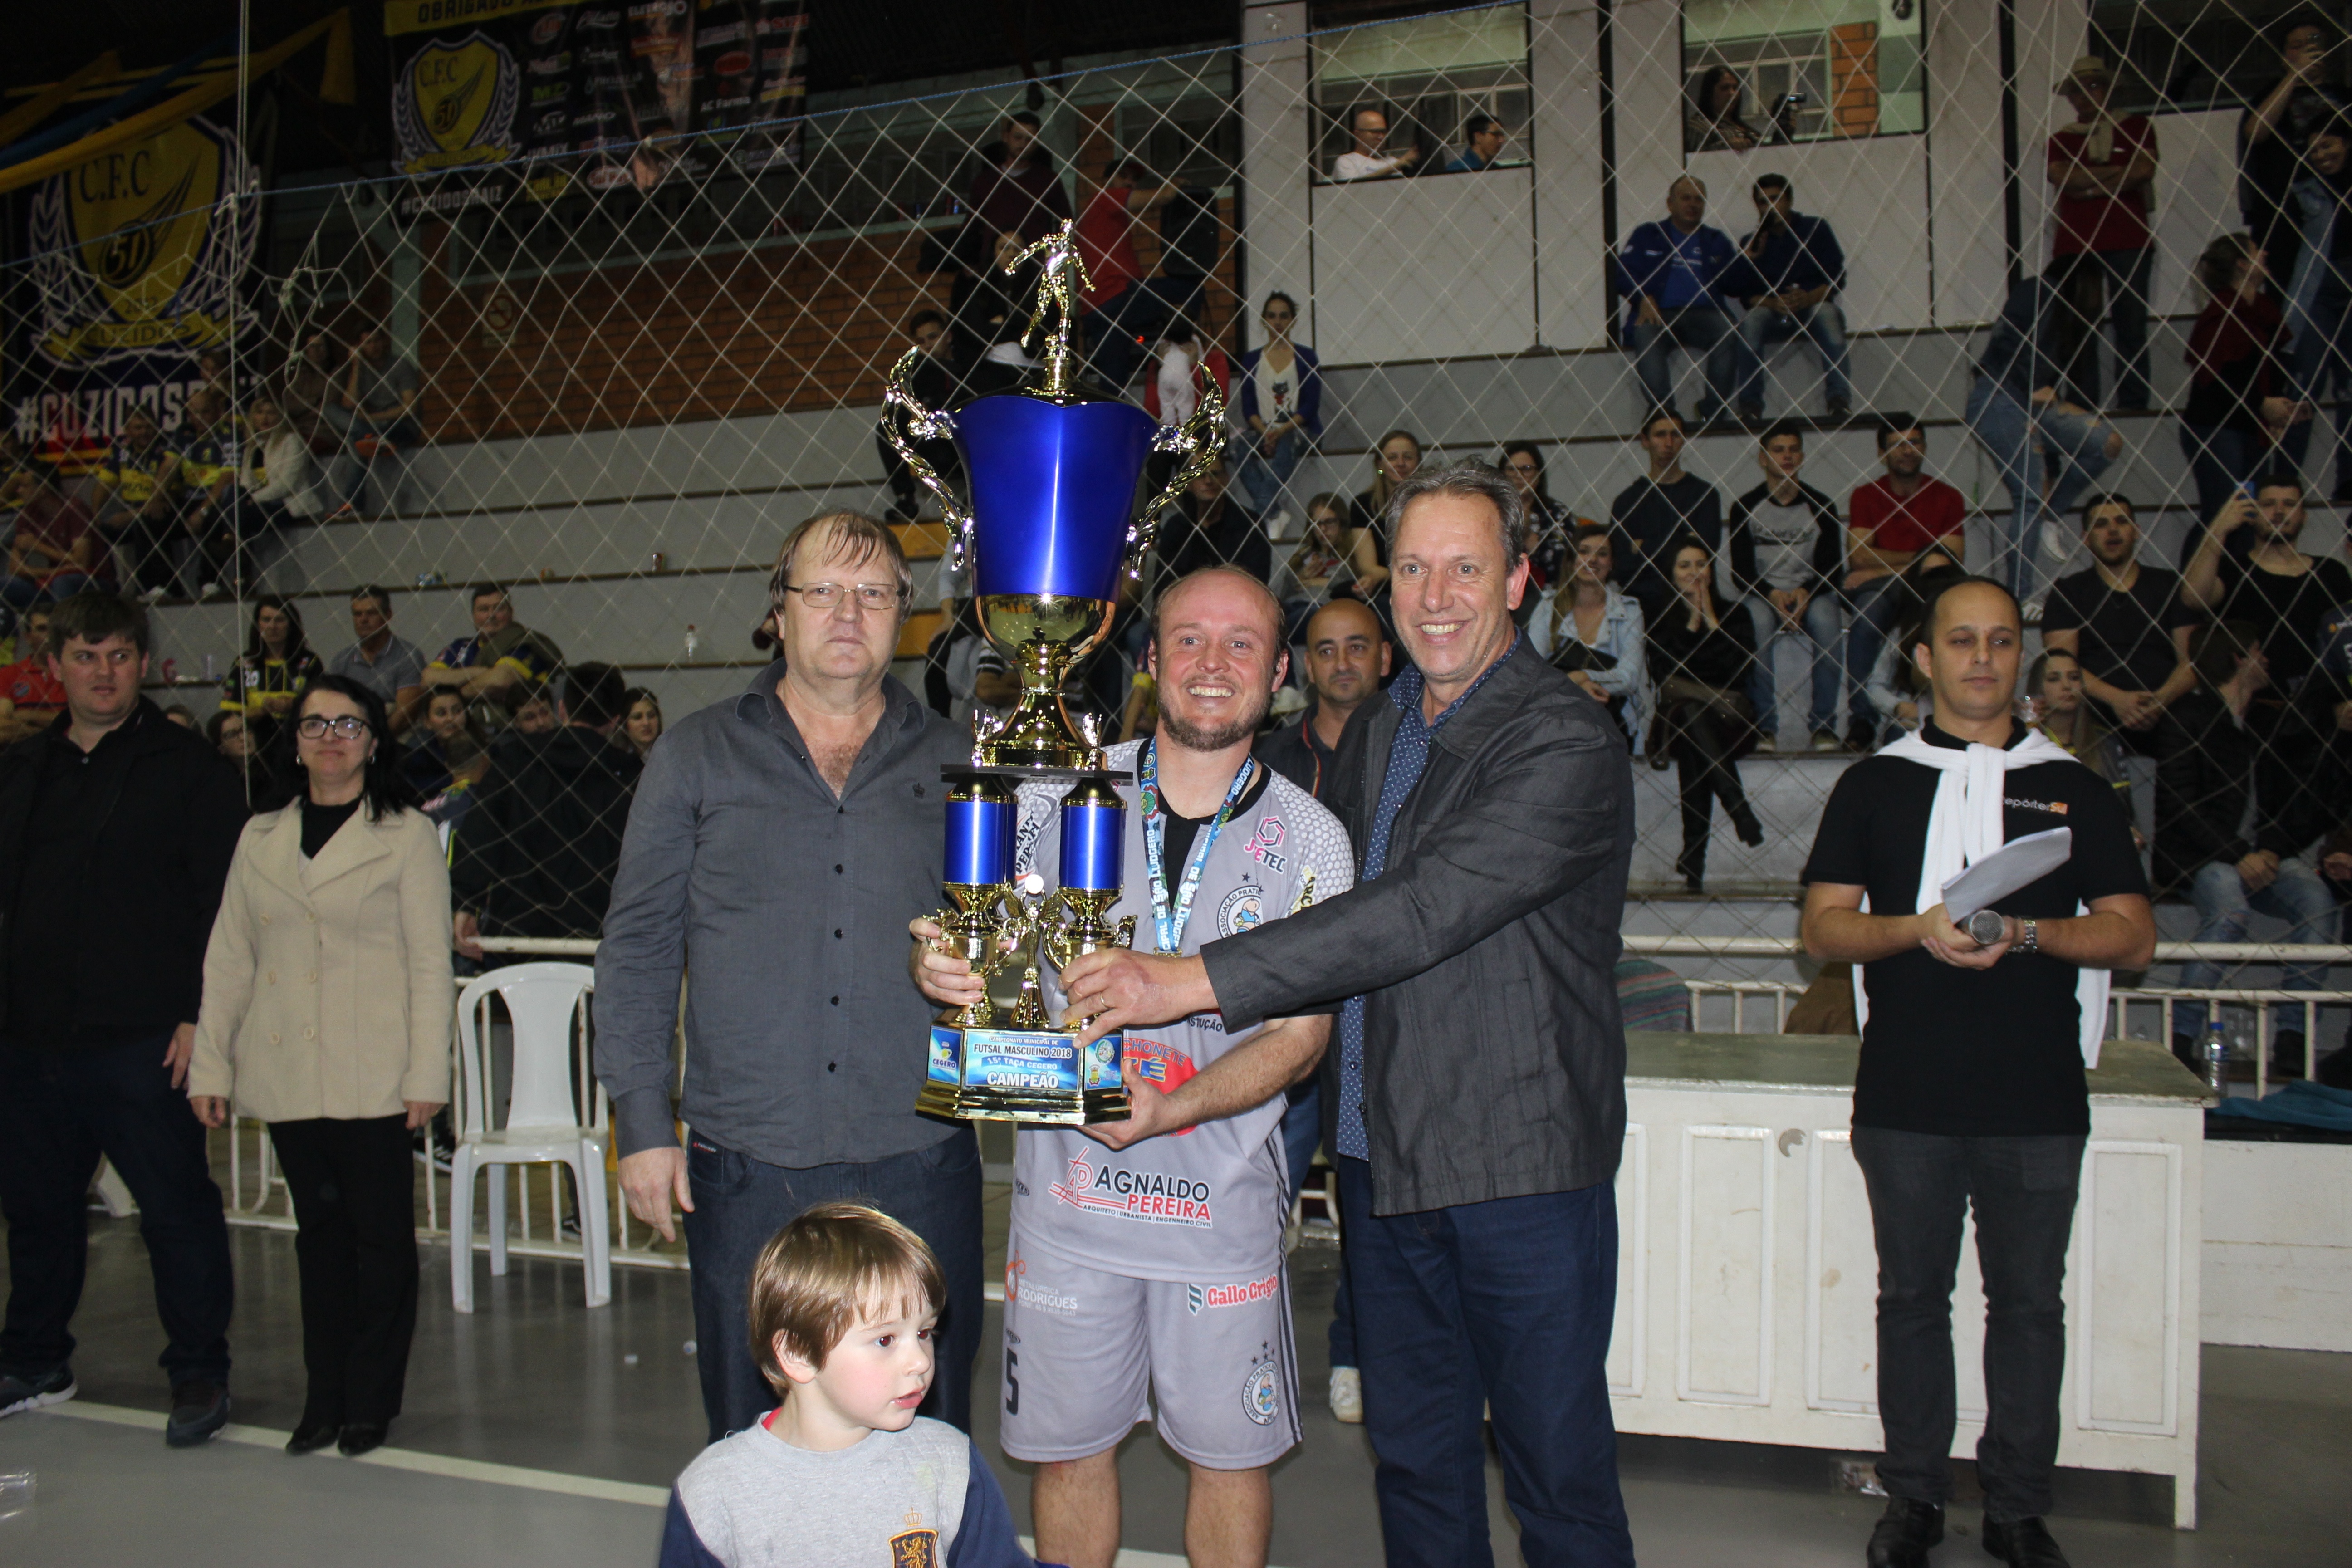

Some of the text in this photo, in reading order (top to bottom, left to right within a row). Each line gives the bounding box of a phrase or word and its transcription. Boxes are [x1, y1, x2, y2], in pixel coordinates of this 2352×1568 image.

[1147, 829, 1161, 878] LUDGERO
[1244, 838, 1286, 873] JETEC
[1188, 866, 1200, 881] DE
[1152, 880, 1166, 903] SÃO
[1181, 882, 1196, 905] SÃO
[1157, 905, 1167, 920] DE
[1220, 893, 1238, 936] ASSOCIAÇÃO
[974, 1044, 1072, 1058] FUTSAL MASCULINO 2018
[933, 1058, 956, 1068] CEGERO
[1003, 1058, 1024, 1068] TAÇA
[1131, 1057, 1167, 1083] É
[987, 1071, 1059, 1088] CAMPEÃO
[1094, 1165, 1210, 1202] AGNALDO
[1083, 1205, 1116, 1215] ARQUITETO
[1119, 1211, 1152, 1221] URBANISTA
[1156, 1216, 1195, 1226] ENGENHEIRO
[1127, 1194, 1210, 1220] PEREIRA
[1018, 1287, 1078, 1310] RODRIGUES
[1207, 1274, 1278, 1306] Gallo Grigio
[1006, 1347, 1019, 1416] 5
